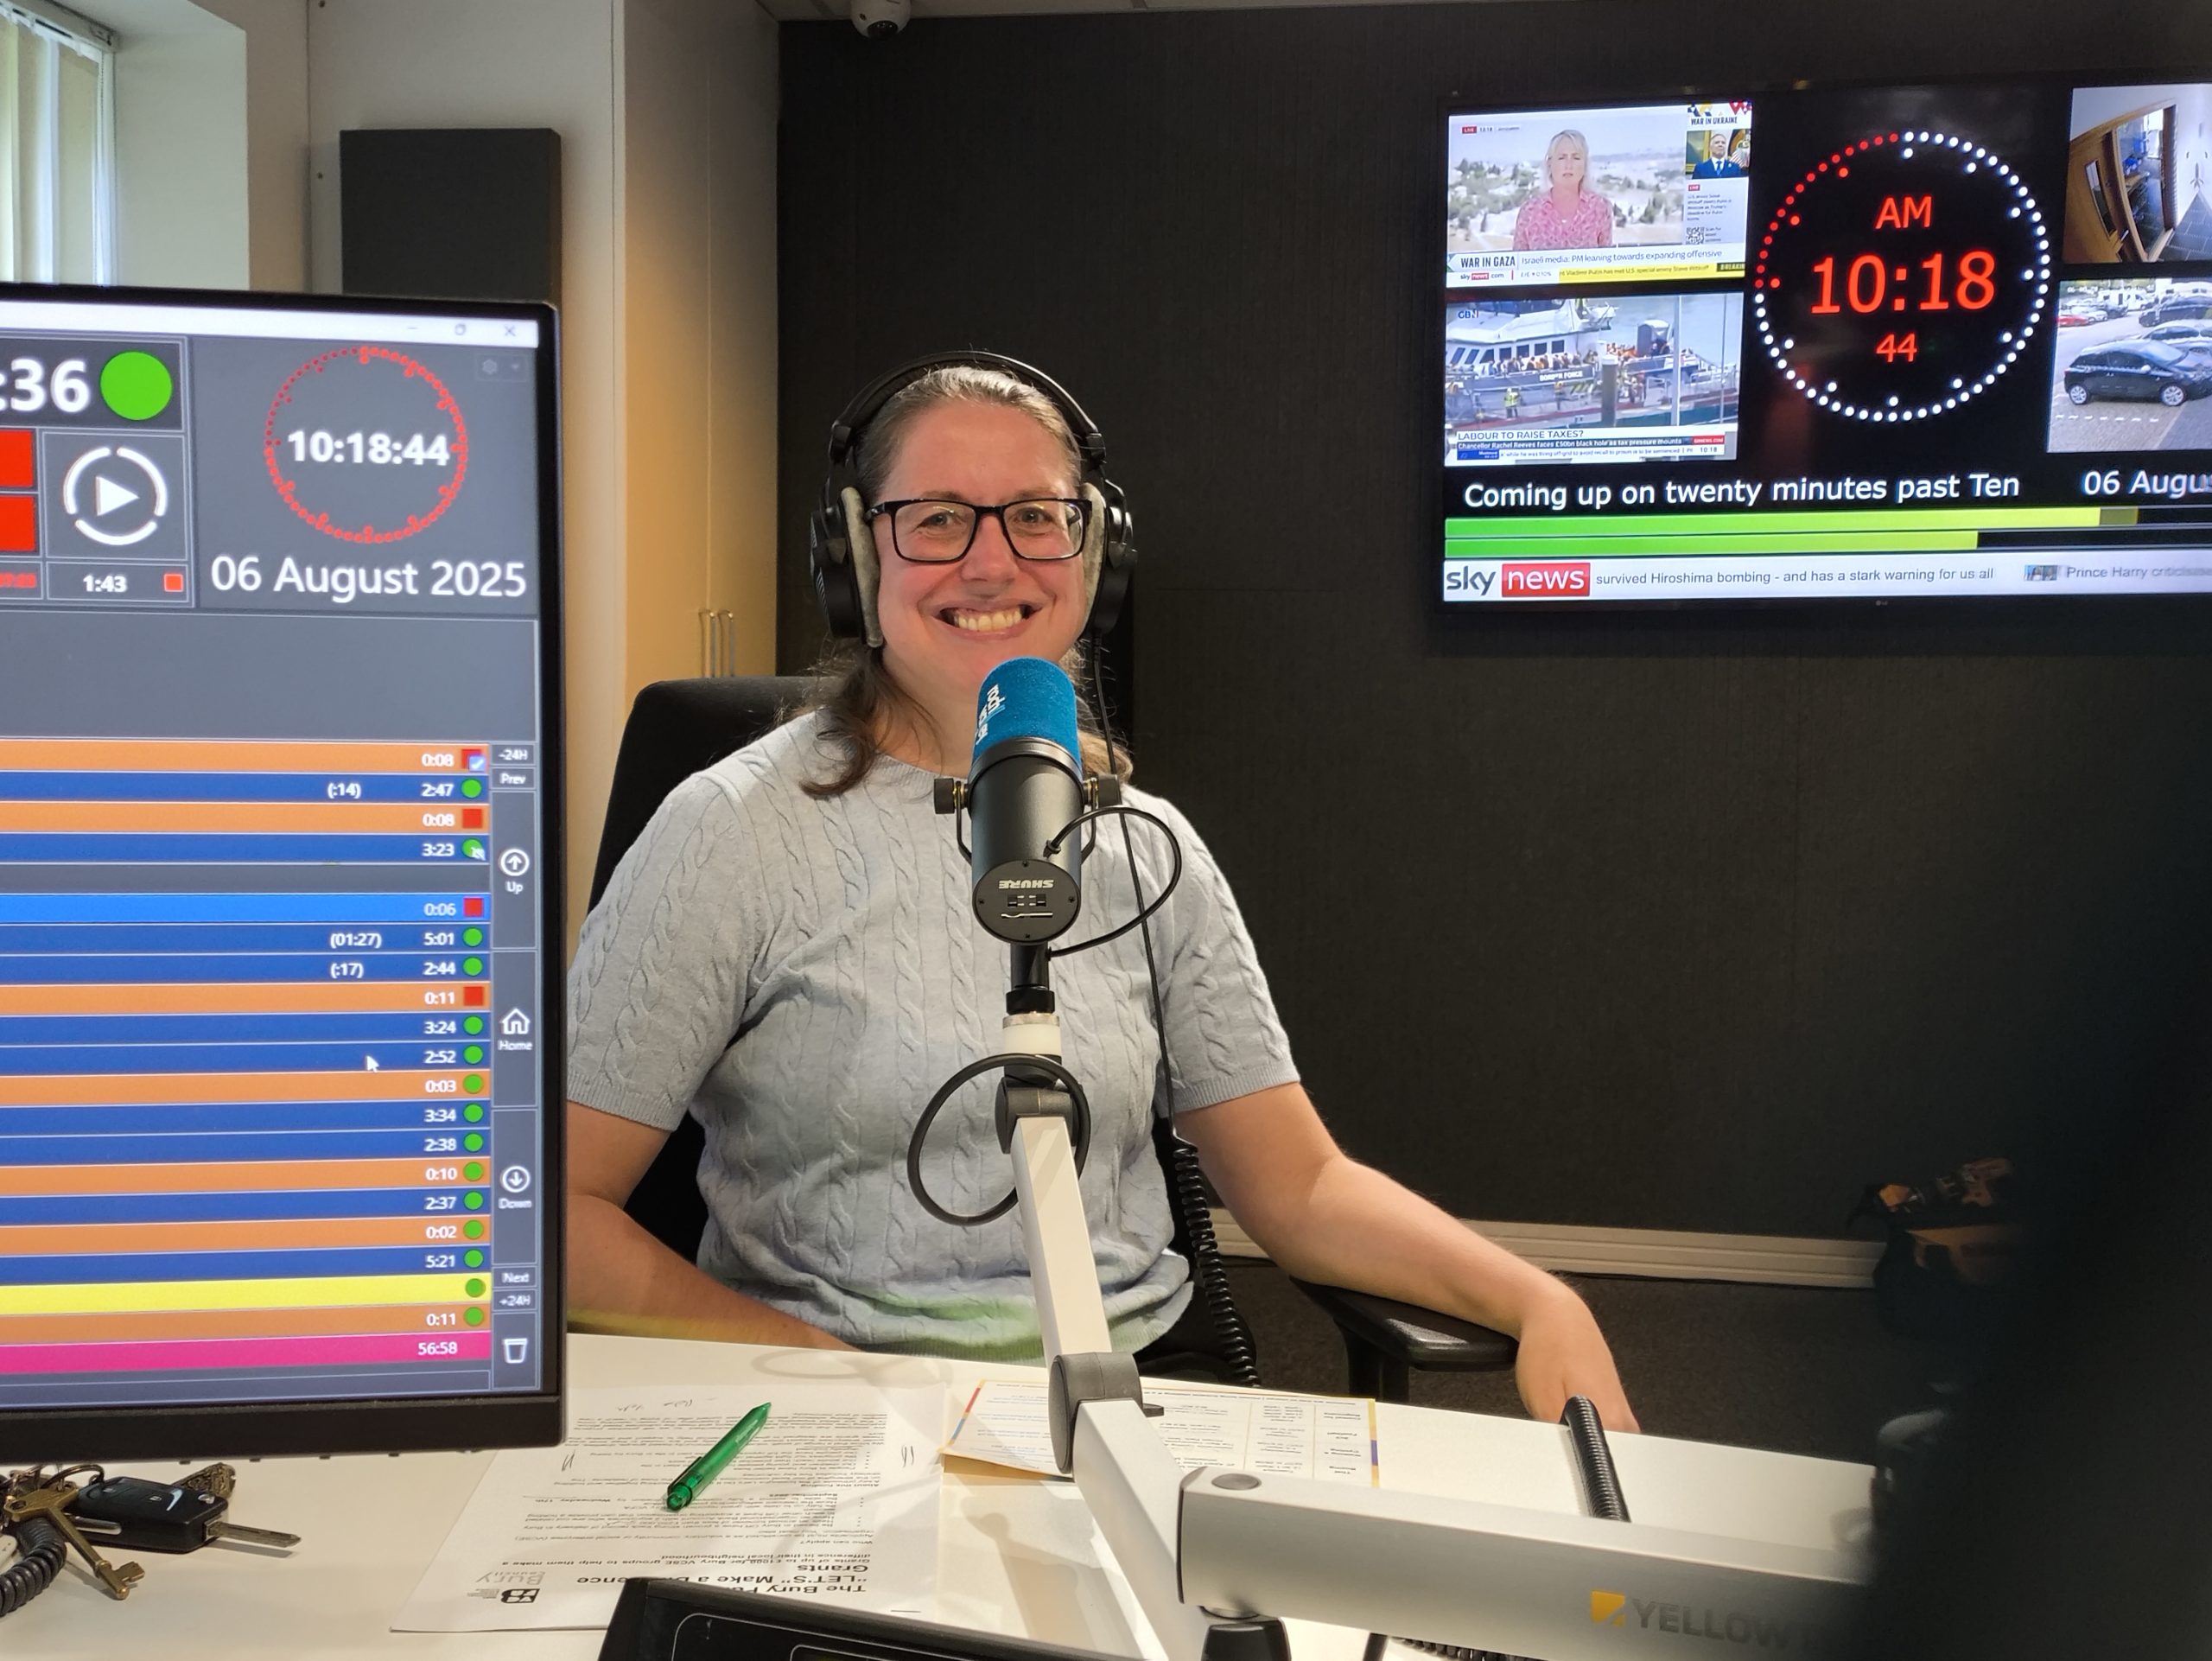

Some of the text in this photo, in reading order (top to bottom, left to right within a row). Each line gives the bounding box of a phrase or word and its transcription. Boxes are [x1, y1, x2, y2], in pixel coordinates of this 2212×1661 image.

[1875, 196, 1933, 229] AM
[1460, 256, 1516, 268] WAR IN GAZA
[1522, 249, 1722, 264] Israeli media: PM leaning towards expanding offensive
[1810, 251, 1996, 315] 10:18
[1875, 334, 1918, 363] 44
[1458, 432, 1499, 441] LABOUR
[1516, 430, 1545, 439] RAISE
[1547, 430, 1584, 438] TAXES?
[287, 430, 450, 467] 10:18:44
[2084, 469, 2212, 499] 06 Augu
[1465, 473, 2019, 511] Coming up on twenty minutes past Ten
[212, 556, 528, 603] 06 August 2025
[1596, 572, 1647, 585] survived
[1651, 572, 1713, 584] Hiroshima
[1718, 570, 1770, 585] bombing
[1783, 570, 1807, 582] and
[1811, 570, 1834, 582] has
[1837, 572, 1846, 581] a
[1849, 570, 1881, 581] stark
[1885, 568, 1935, 582] warning
[1939, 568, 1957, 580] for
[1960, 570, 1975, 579] us
[1979, 567, 1994, 579] all
[2066, 566, 2108, 579] Prince
[2112, 566, 2148, 580] Harry
[83, 575, 128, 593] 1:43
[1446, 565, 1586, 596] sky news
[422, 754, 454, 767] 0:08
[499, 749, 529, 761] -24H
[499, 773, 526, 785] Prev
[327, 783, 362, 799] (:14)
[421, 783, 454, 798] 2:47
[423, 813, 455, 827] 0:08
[422, 843, 455, 857] 3:23
[505, 881, 524, 895] Up
[999, 879, 1054, 889] SHURE
[423, 902, 457, 917] 0:06
[330, 932, 383, 950] (01:27)
[423, 932, 455, 946] 5:01
[330, 963, 365, 979] (:17)
[423, 962, 456, 977] 2:44
[424, 991, 456, 1005] 0:11
[423, 1021, 457, 1034] 3:24
[498, 1041, 533, 1052] Home
[423, 1051, 457, 1065] 2:52
[424, 1079, 457, 1093] 0:03
[423, 1109, 457, 1123] 3:34
[423, 1138, 457, 1153] 2:38
[425, 1168, 458, 1181] 0:10
[424, 1196, 457, 1211] 2:37
[425, 1225, 457, 1239] 0:02
[424, 1255, 456, 1269] 5:21
[502, 1272, 531, 1284] Next
[499, 1295, 531, 1308] +24H
[426, 1313, 457, 1327] 0:11
[417, 1341, 459, 1356] 56:58
[797, 1564, 869, 1573] Grants
[475, 1571, 543, 1586] Bury
[716, 1575, 773, 1584] Make
[766, 1584, 818, 1594] Bury
[826, 1584, 867, 1593] The
